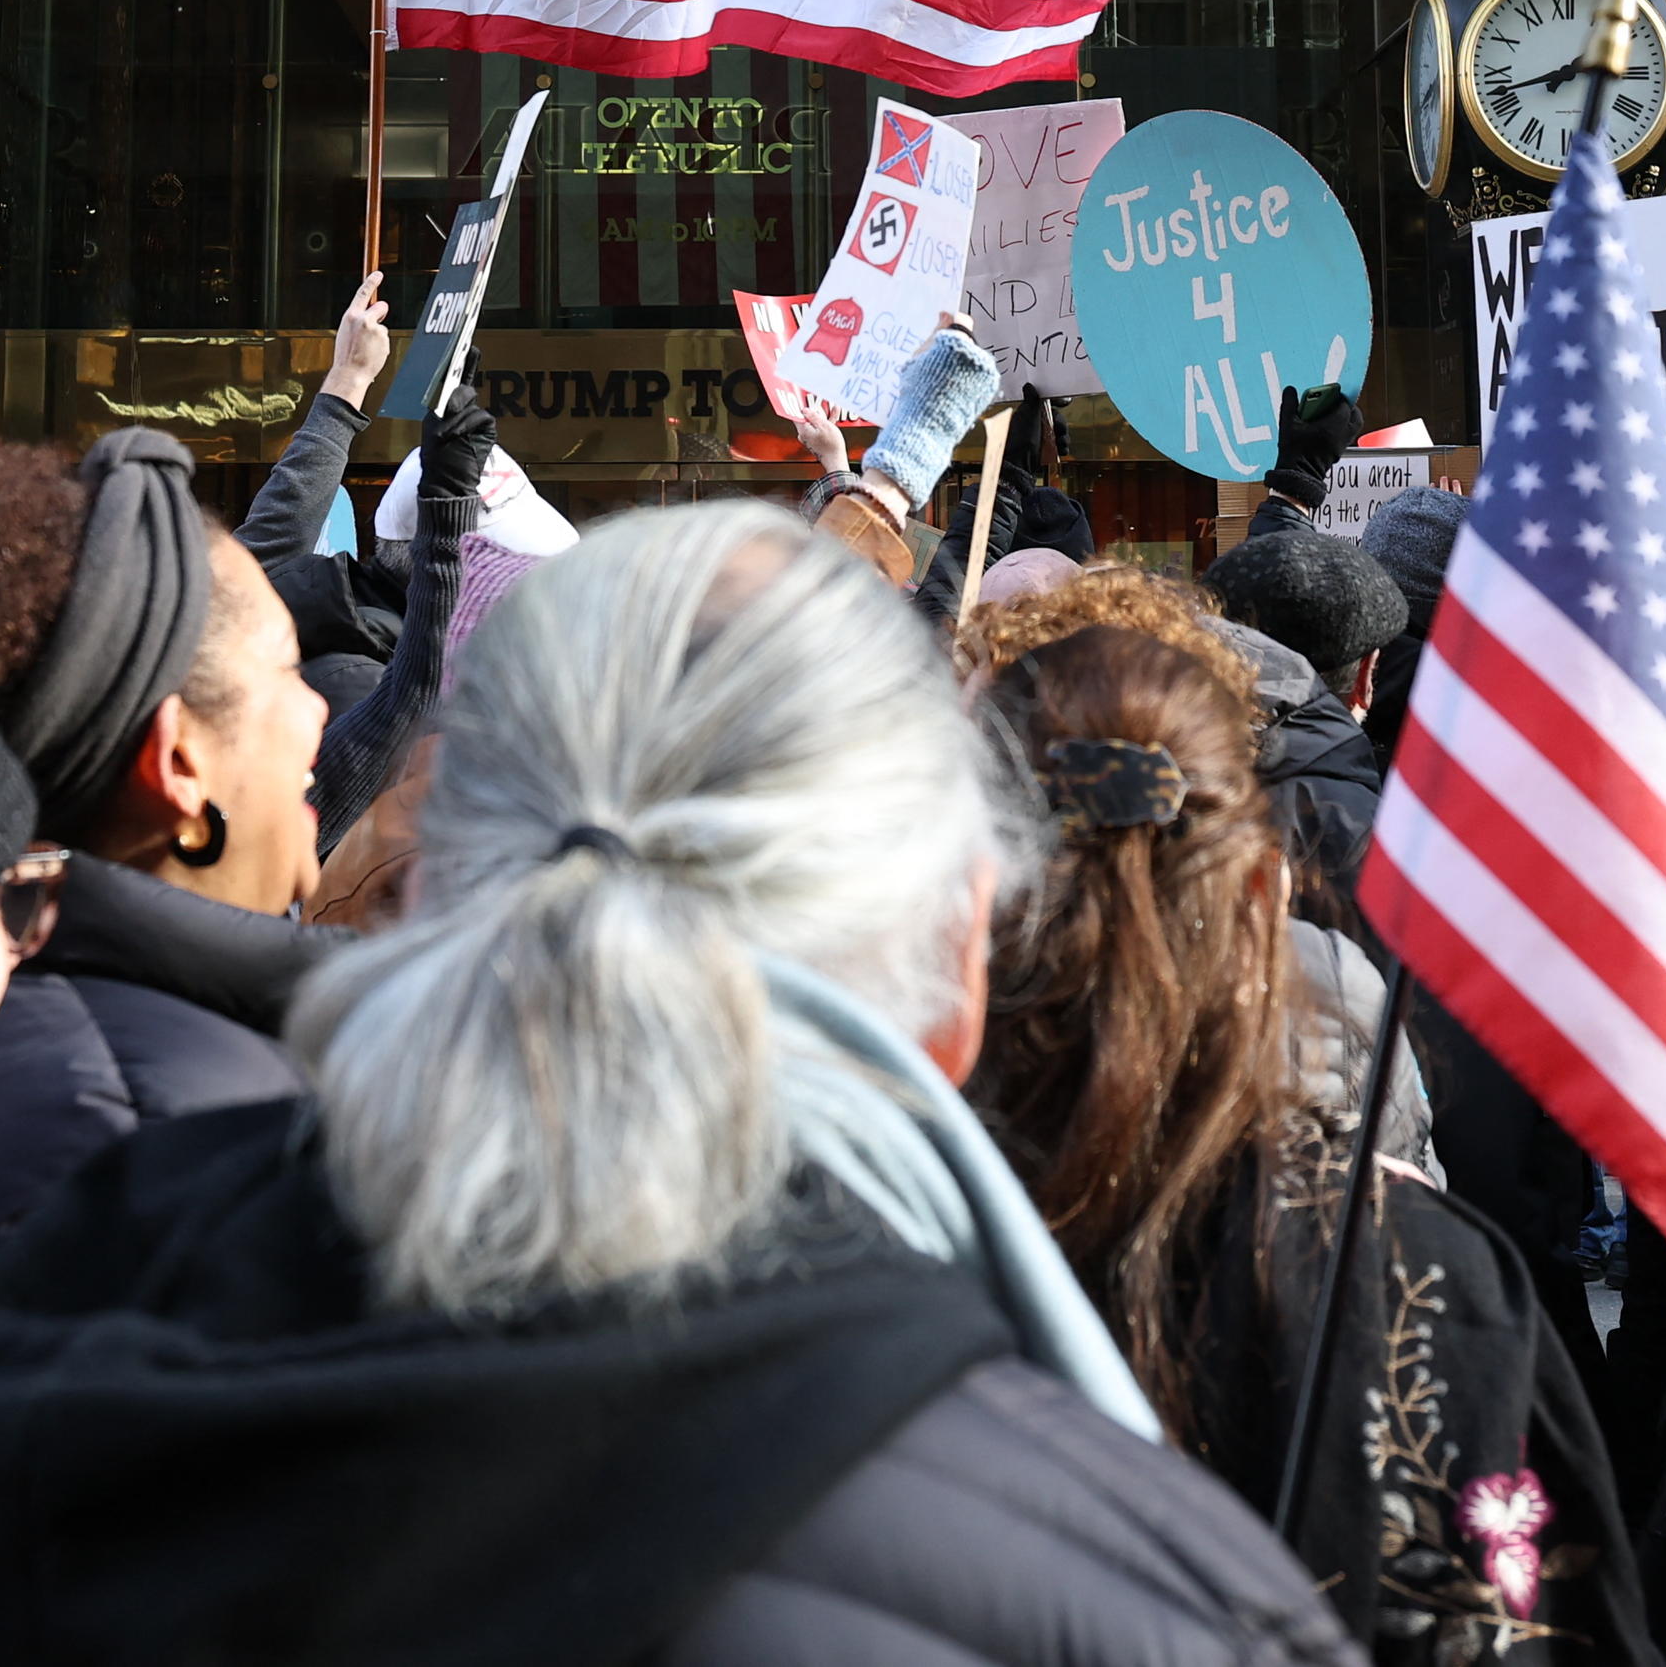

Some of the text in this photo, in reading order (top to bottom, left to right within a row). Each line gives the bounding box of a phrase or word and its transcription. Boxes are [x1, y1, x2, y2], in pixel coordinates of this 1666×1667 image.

[597, 97, 703, 129] OPEN
[1103, 169, 1290, 273] Justice
[451, 221, 480, 266] NO
[823, 308, 855, 332] MAGA
[1192, 272, 1236, 344] 4
[1368, 457, 1414, 488] arent
[1337, 499, 1361, 524] the
